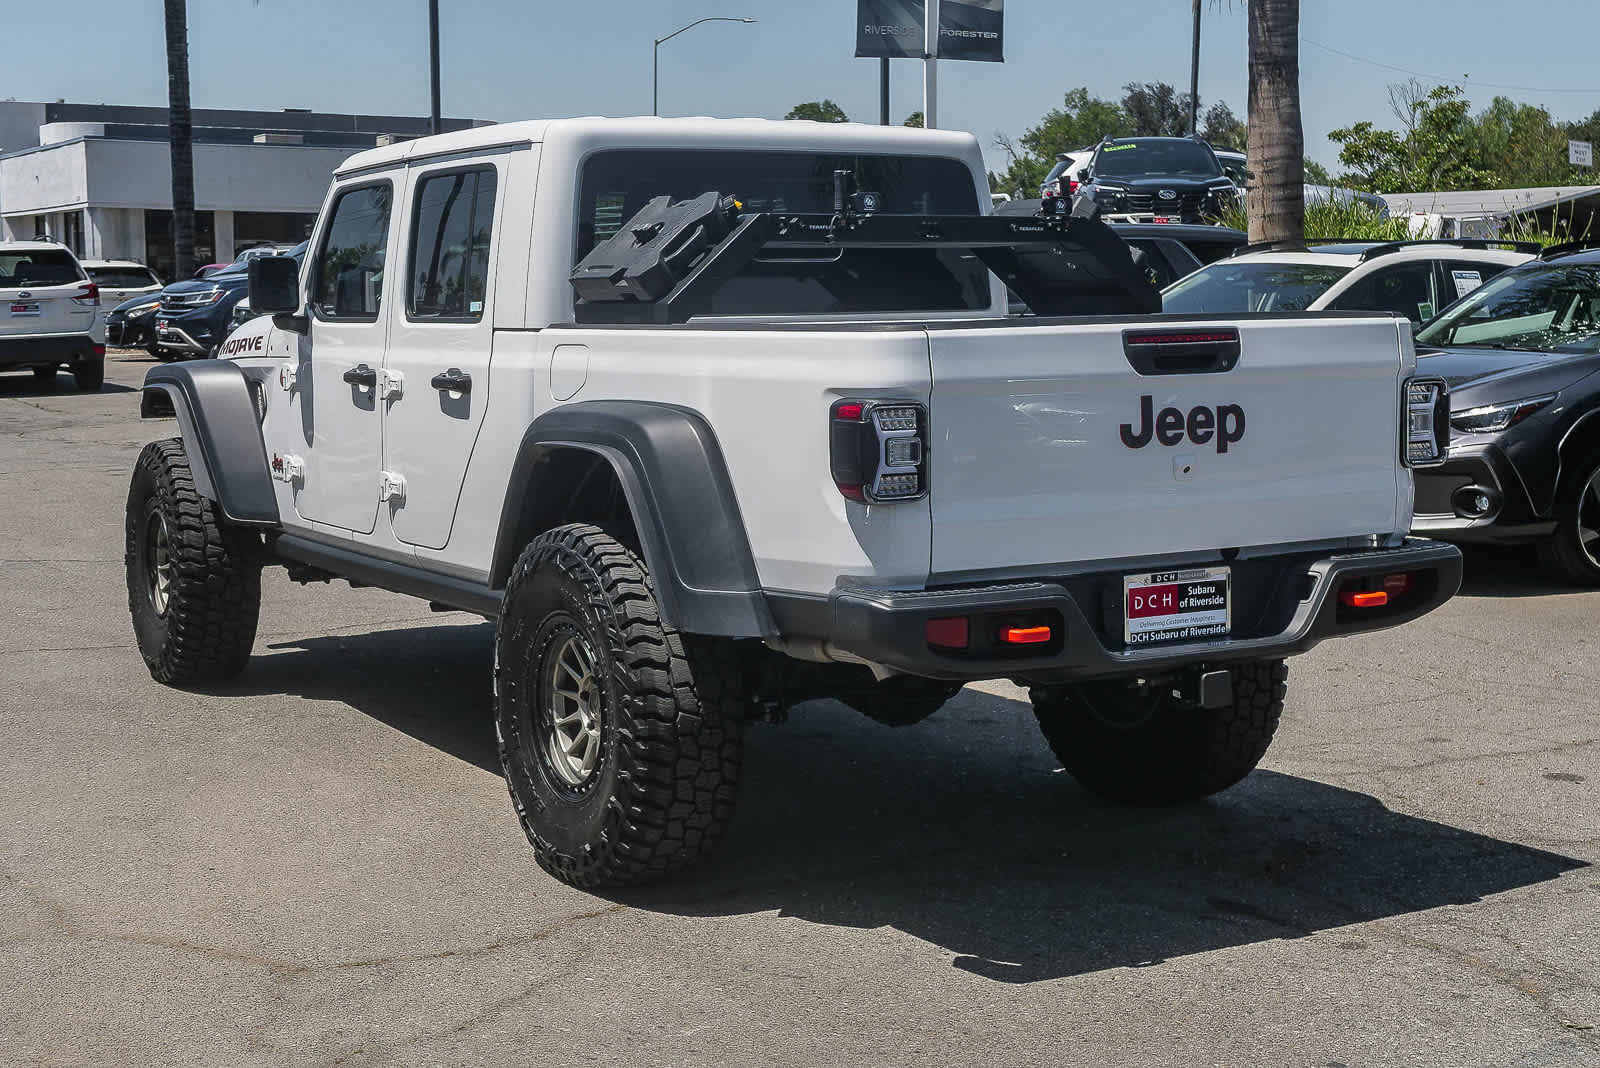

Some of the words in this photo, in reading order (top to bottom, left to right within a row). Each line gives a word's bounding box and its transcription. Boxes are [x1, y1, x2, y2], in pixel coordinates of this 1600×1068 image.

[864, 24, 916, 35] RIVERSIDE
[940, 29, 999, 39] FORESTER
[220, 336, 263, 356] MOJAVE
[1120, 395, 1246, 454] Jeep
[1187, 585, 1216, 596] Subaru
[1134, 593, 1172, 610] DCH
[1179, 599, 1189, 608] of
[1189, 595, 1225, 607] Riverside
[1165, 616, 1190, 626] Customer
[1131, 632, 1149, 643] DCH
[1150, 629, 1179, 641] Subaru
[1180, 628, 1189, 638] of
[1189, 624, 1226, 636] Riverside
